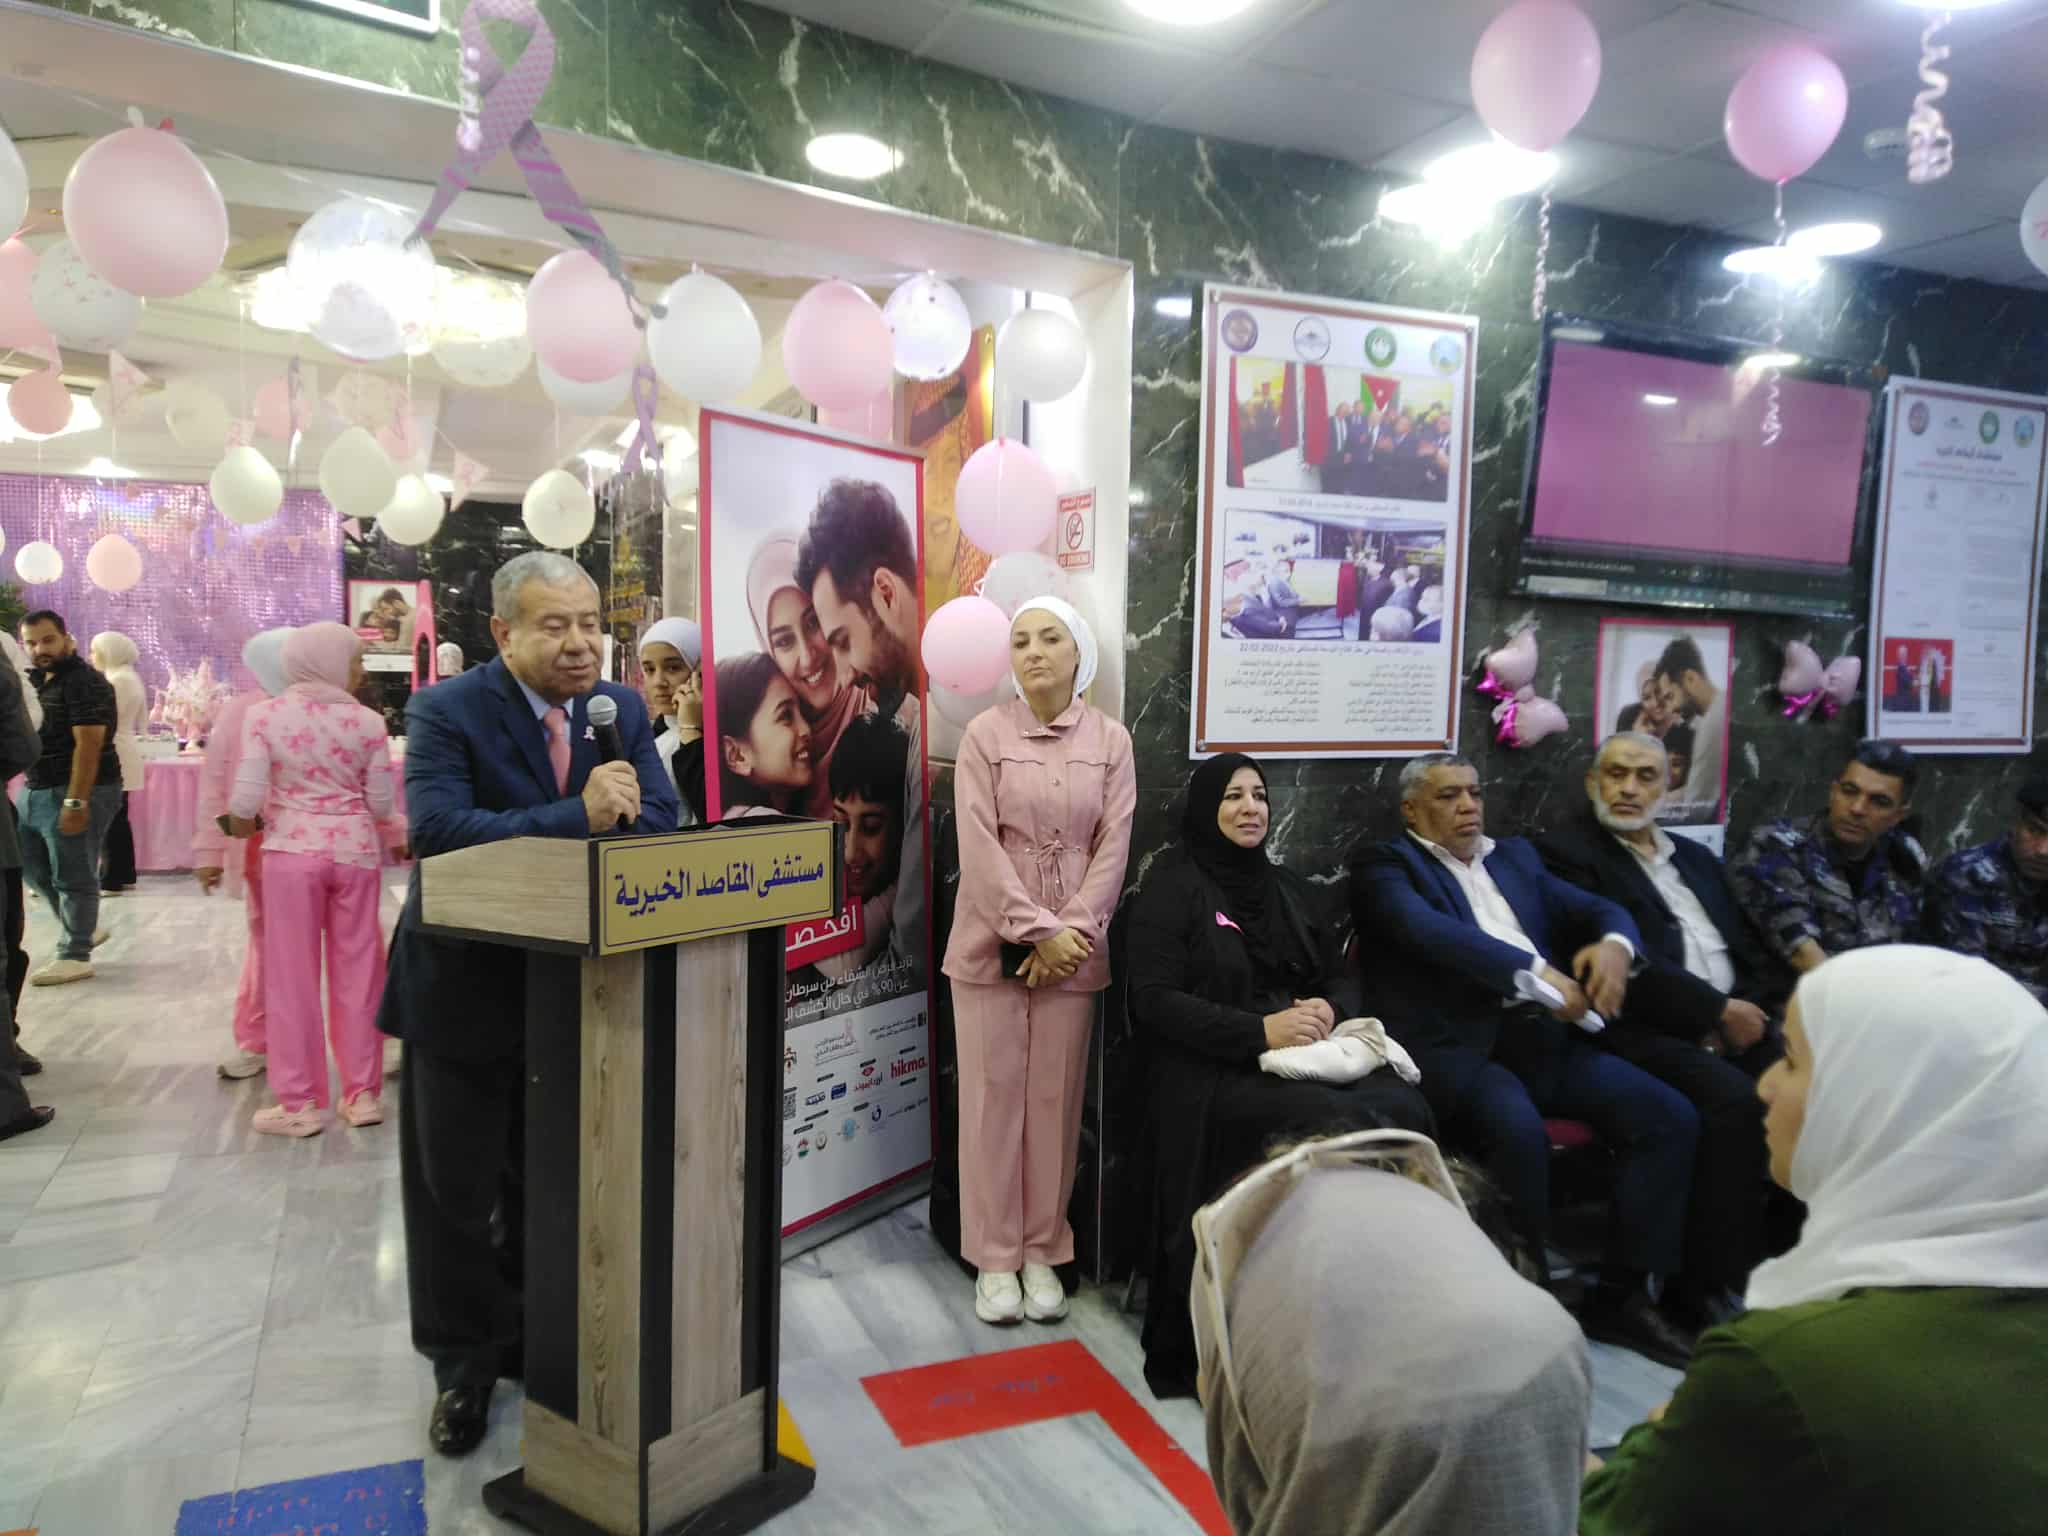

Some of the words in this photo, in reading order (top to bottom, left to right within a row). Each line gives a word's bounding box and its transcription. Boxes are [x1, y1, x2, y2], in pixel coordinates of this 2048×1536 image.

[696, 861, 754, 897] المقاصد
[757, 853, 824, 898] مستشفى
[615, 868, 690, 917] الخيرية
[785, 904, 857, 952] افحص
[820, 975, 836, 992] من
[837, 966, 872, 985] الشفاء
[784, 982, 819, 1003] سرطان
[832, 992, 852, 1010] حال
[853, 990, 869, 1008] في
[794, 993, 832, 1018] الكشف
